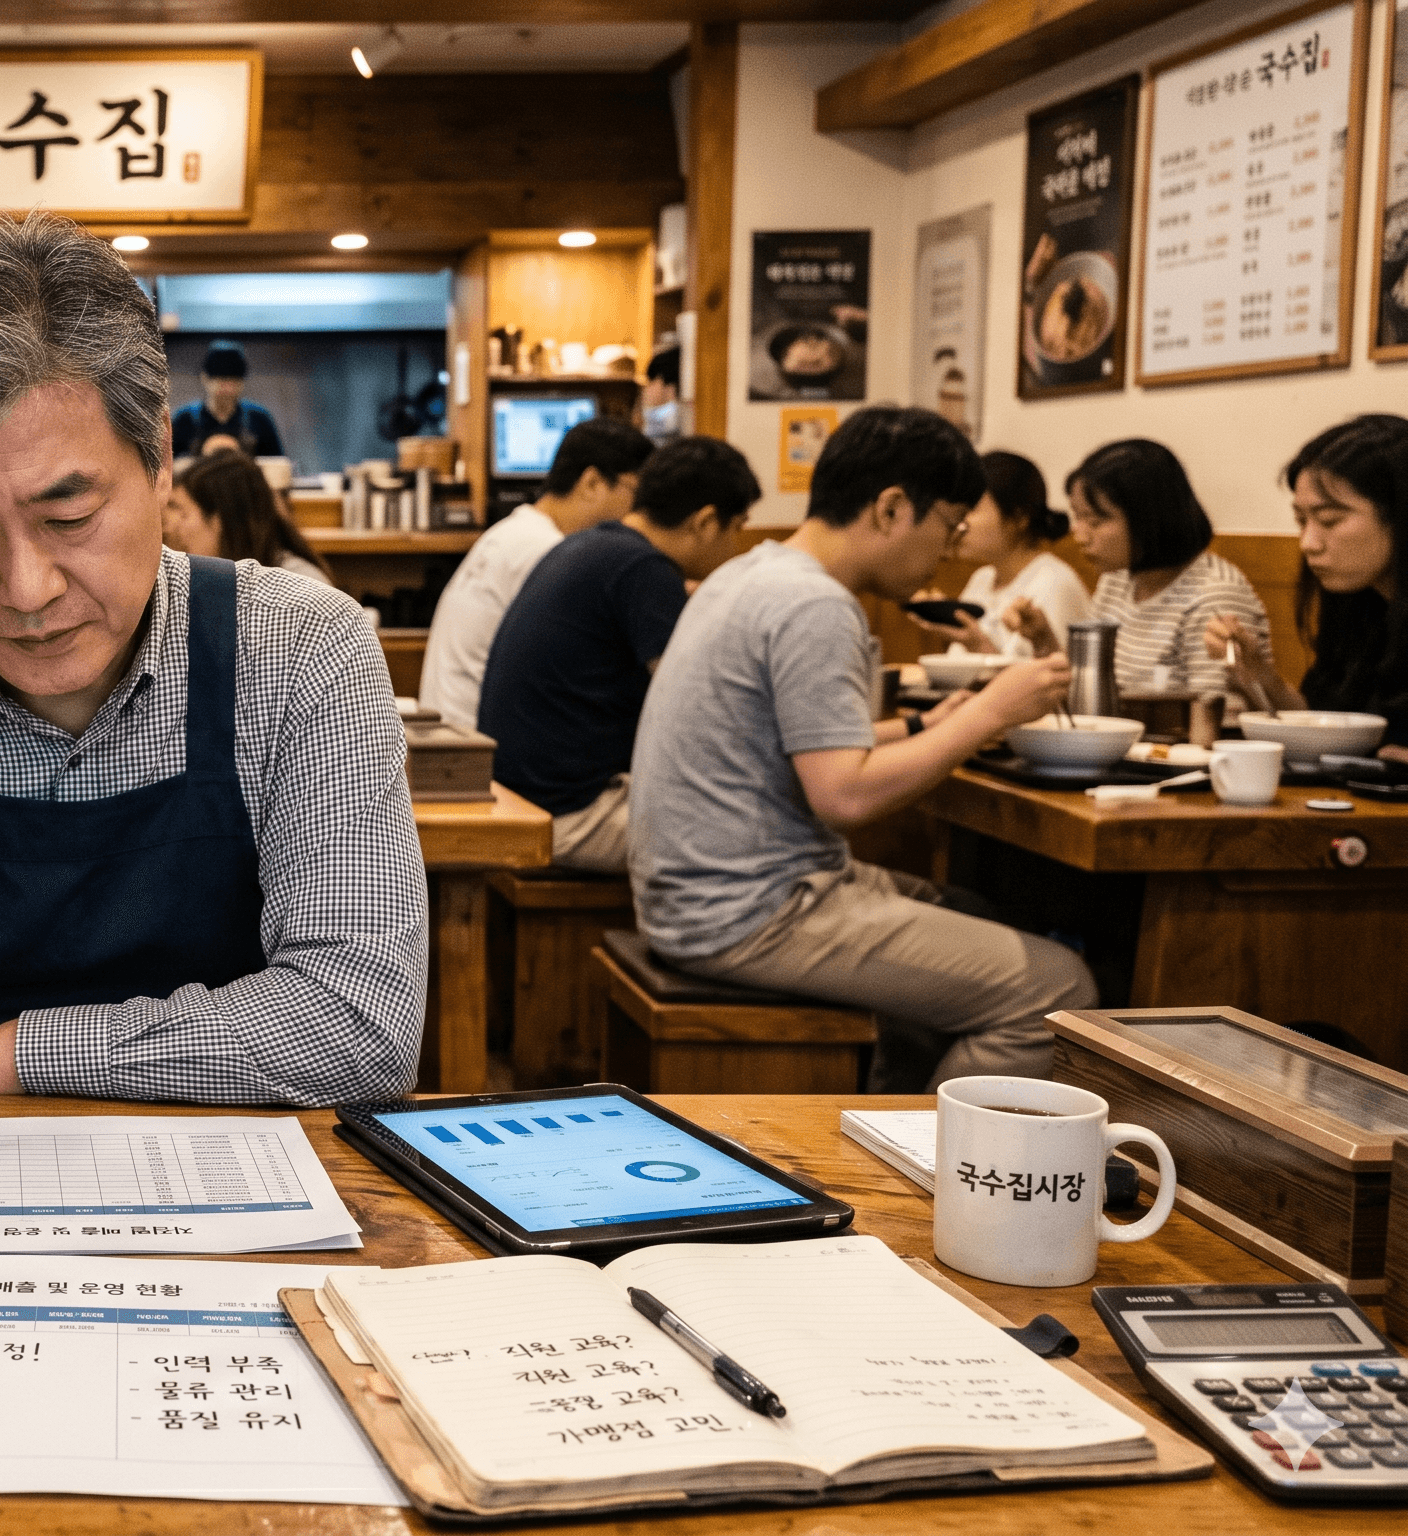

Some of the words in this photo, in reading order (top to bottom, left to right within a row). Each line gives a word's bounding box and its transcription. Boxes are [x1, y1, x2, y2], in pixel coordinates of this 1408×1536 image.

[957, 1162, 1086, 1202] 국수집시장
[48, 1281, 68, 1295] 및
[79, 1282, 125, 1296] 운영
[135, 1284, 183, 1297] 현황
[154, 1356, 211, 1373] 인력
[227, 1356, 283, 1374] 부족
[154, 1381, 214, 1400] 물류
[229, 1384, 292, 1401] 관리
[158, 1410, 220, 1430] 품질
[239, 1411, 302, 1430] 유지
